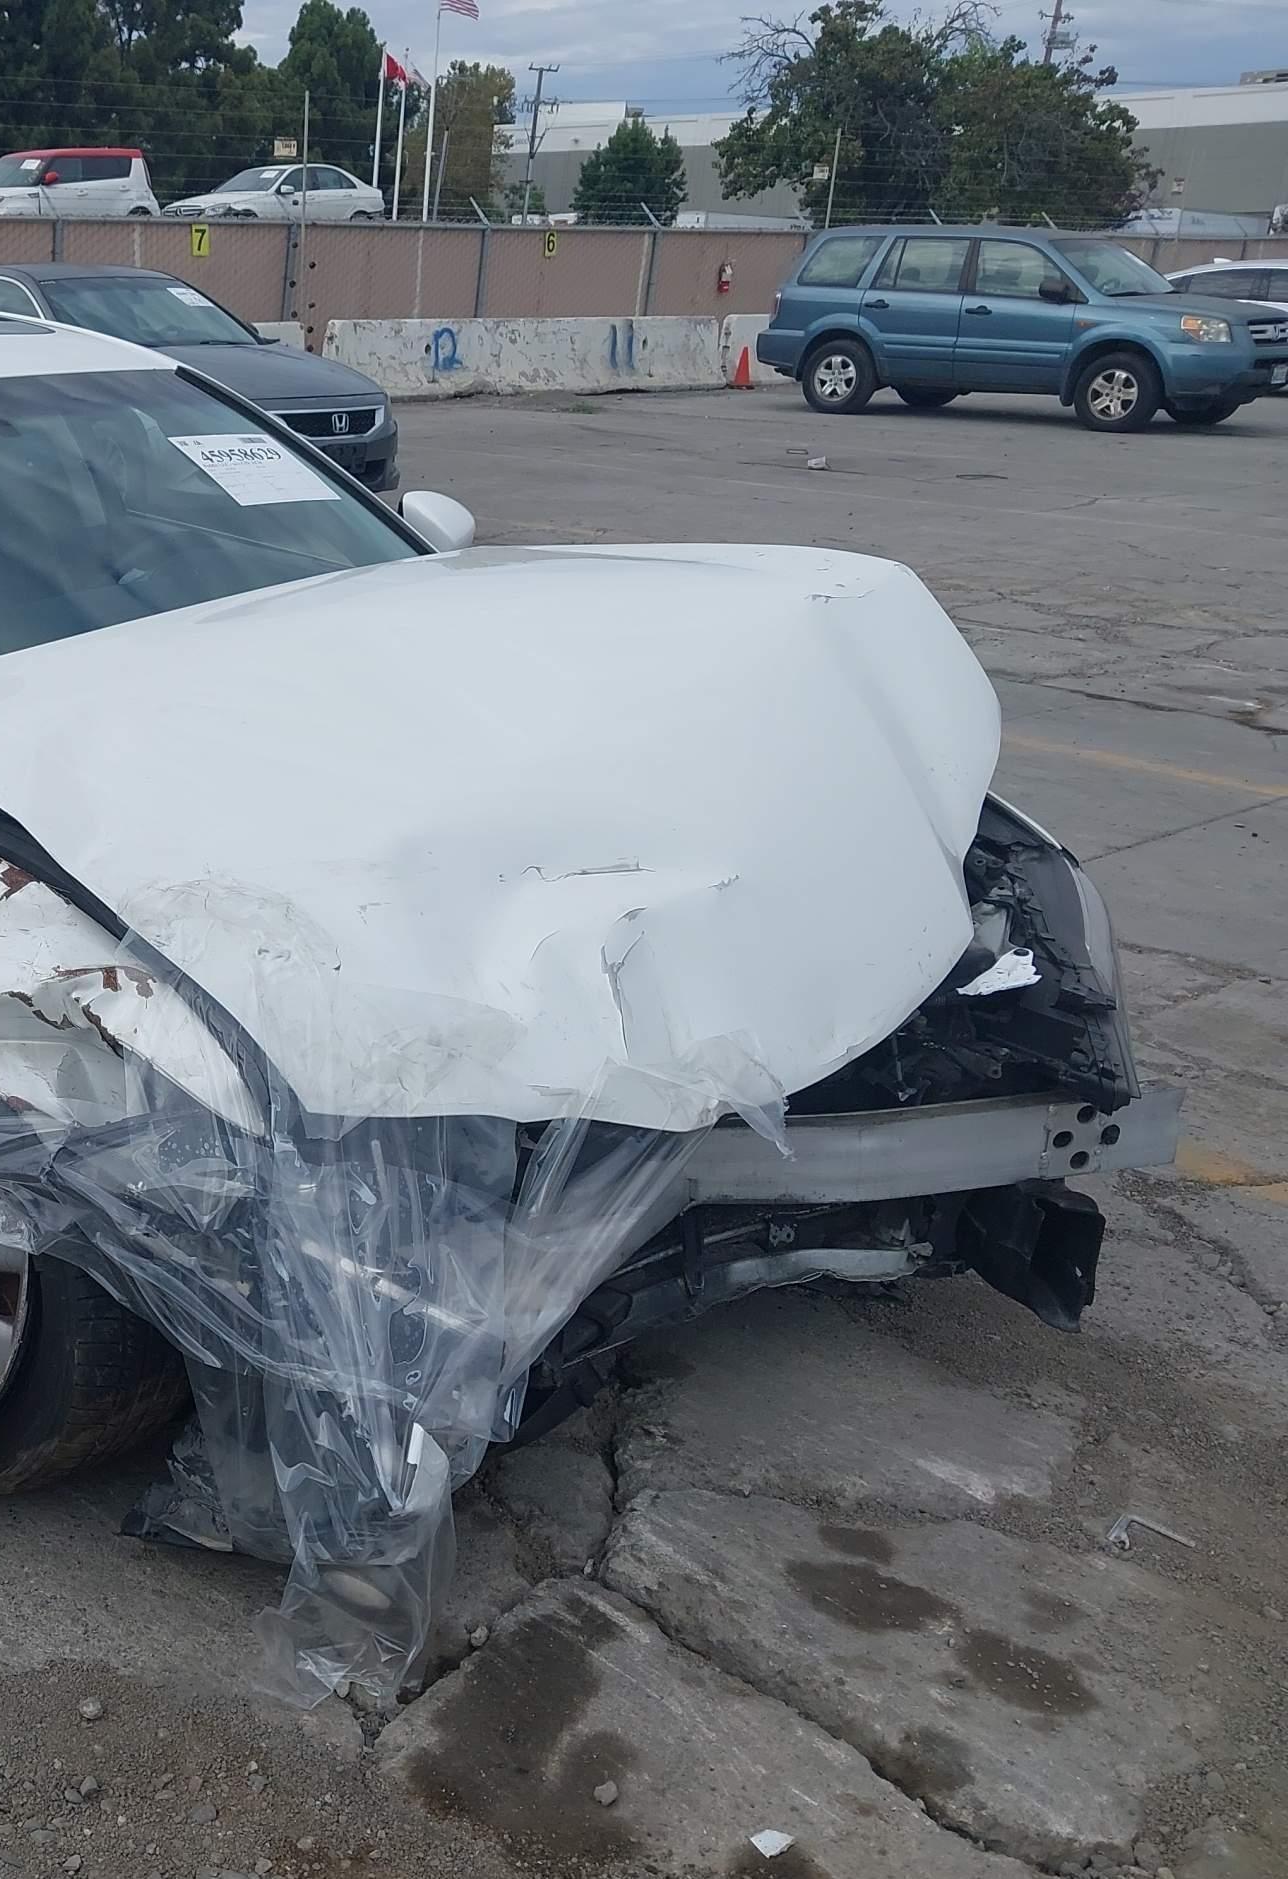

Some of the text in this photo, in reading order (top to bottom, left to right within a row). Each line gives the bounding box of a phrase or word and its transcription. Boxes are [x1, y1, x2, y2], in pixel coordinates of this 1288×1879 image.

[194, 228, 207, 252] 7
[547, 232, 556, 253] 6
[200, 447, 282, 464] 45958629
